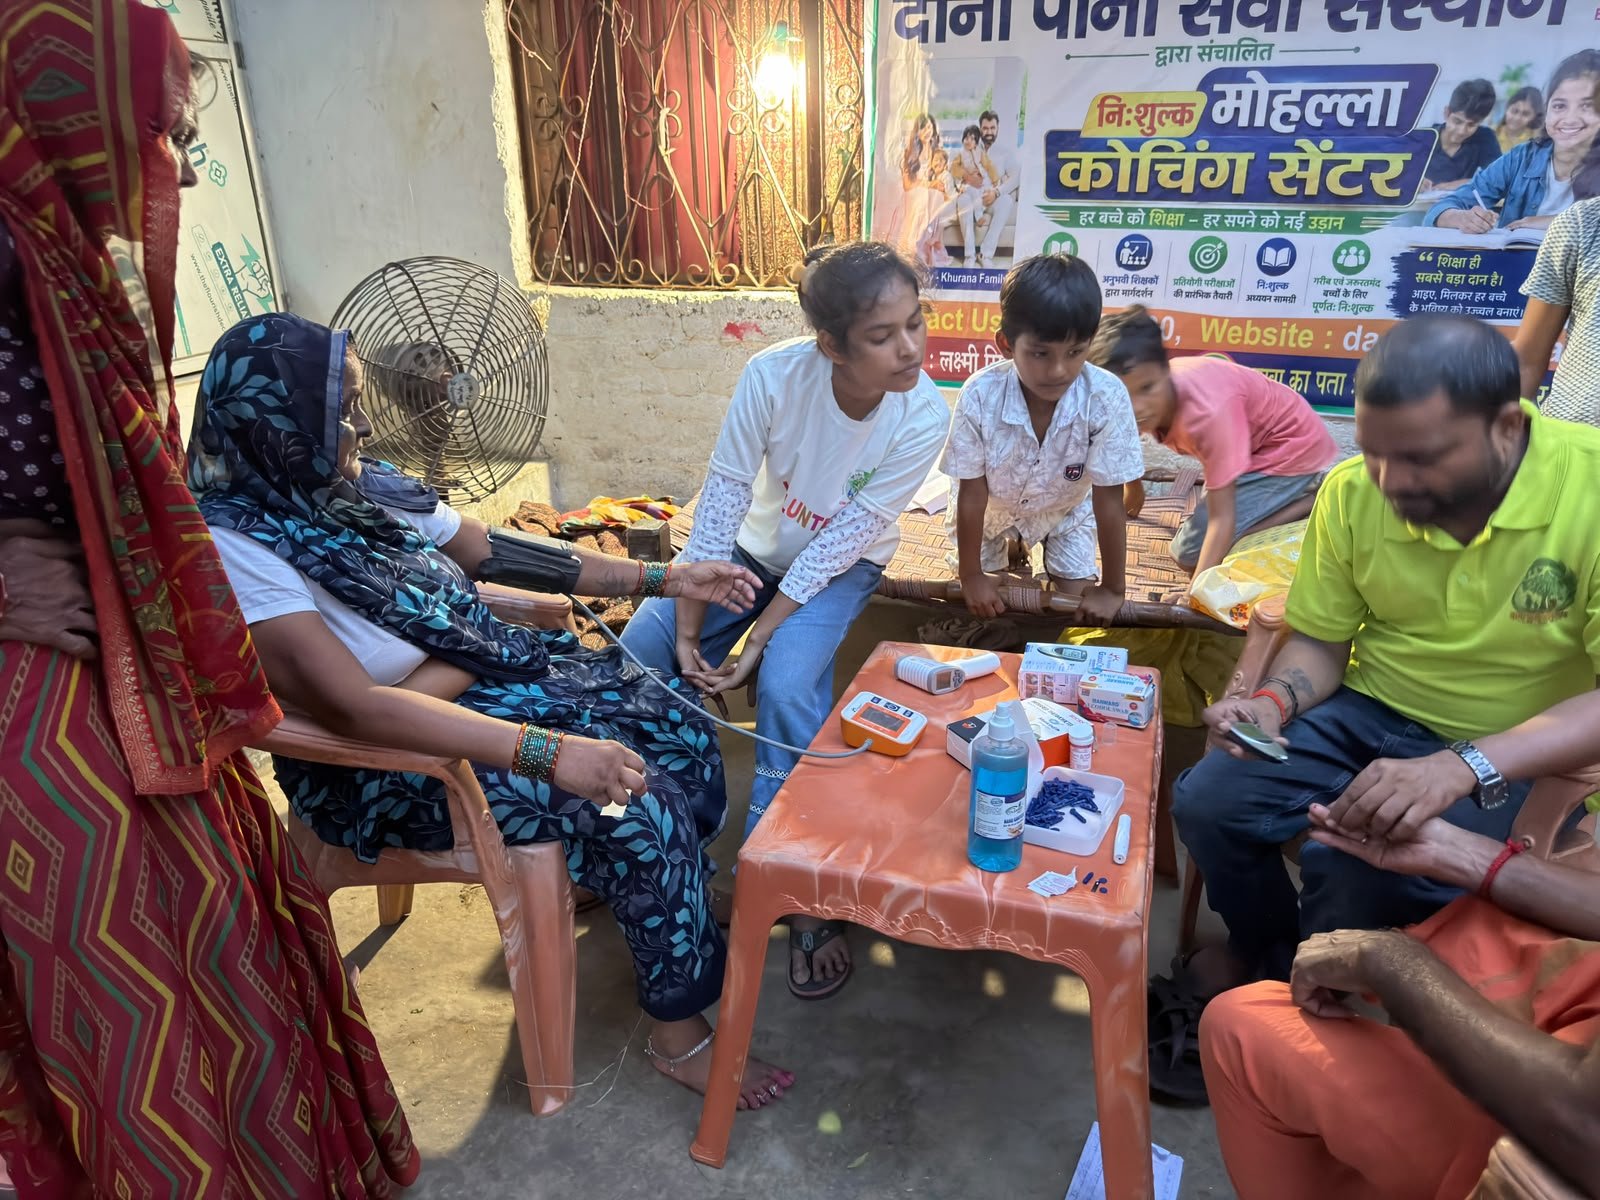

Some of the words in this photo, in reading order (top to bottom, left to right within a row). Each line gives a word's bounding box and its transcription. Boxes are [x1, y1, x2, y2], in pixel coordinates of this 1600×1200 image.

[1155, 46, 1191, 67] द्वारा
[1198, 37, 1275, 63] संचालित
[1211, 71, 1409, 133] मोहल्ला
[1058, 139, 1255, 195] कोचिंग
[1268, 139, 1412, 197] सेंटर
[1079, 211, 1098, 226] हर
[1099, 207, 1124, 226] बच्चे
[1126, 208, 1146, 226] को
[1149, 209, 1186, 227] शिक्षा
[1203, 214, 1221, 228] हर
[1223, 210, 1257, 228] सपने
[1260, 210, 1281, 228] को
[1284, 211, 1306, 229] नई
[1308, 214, 1345, 232] उड़ान
[1437, 253, 1467, 268] शिक्षा
[1469, 254, 1482, 270] ही
[215, 248, 234, 285] EXTRA
[231, 286, 251, 320] RELIA
[940, 271, 977, 284] Khurana
[1415, 270, 1443, 284] सबसे
[1445, 273, 1466, 287] बड़ा
[1468, 273, 1489, 286] दान
[191, 253, 226, 332] www.theflourishdec
[1173, 288, 1184, 299] की
[1342, 288, 1351, 298] के
[1440, 288, 1473, 301] मिलकर
[1474, 291, 1487, 302] हर
[1488, 290, 1507, 303] बच्चे
[1409, 301, 1419, 313] के
[1200, 317, 1315, 349] Website
[1342, 325, 1379, 352] da
[939, 344, 980, 374] लक्ष्मी
[1315, 371, 1347, 397] पता
